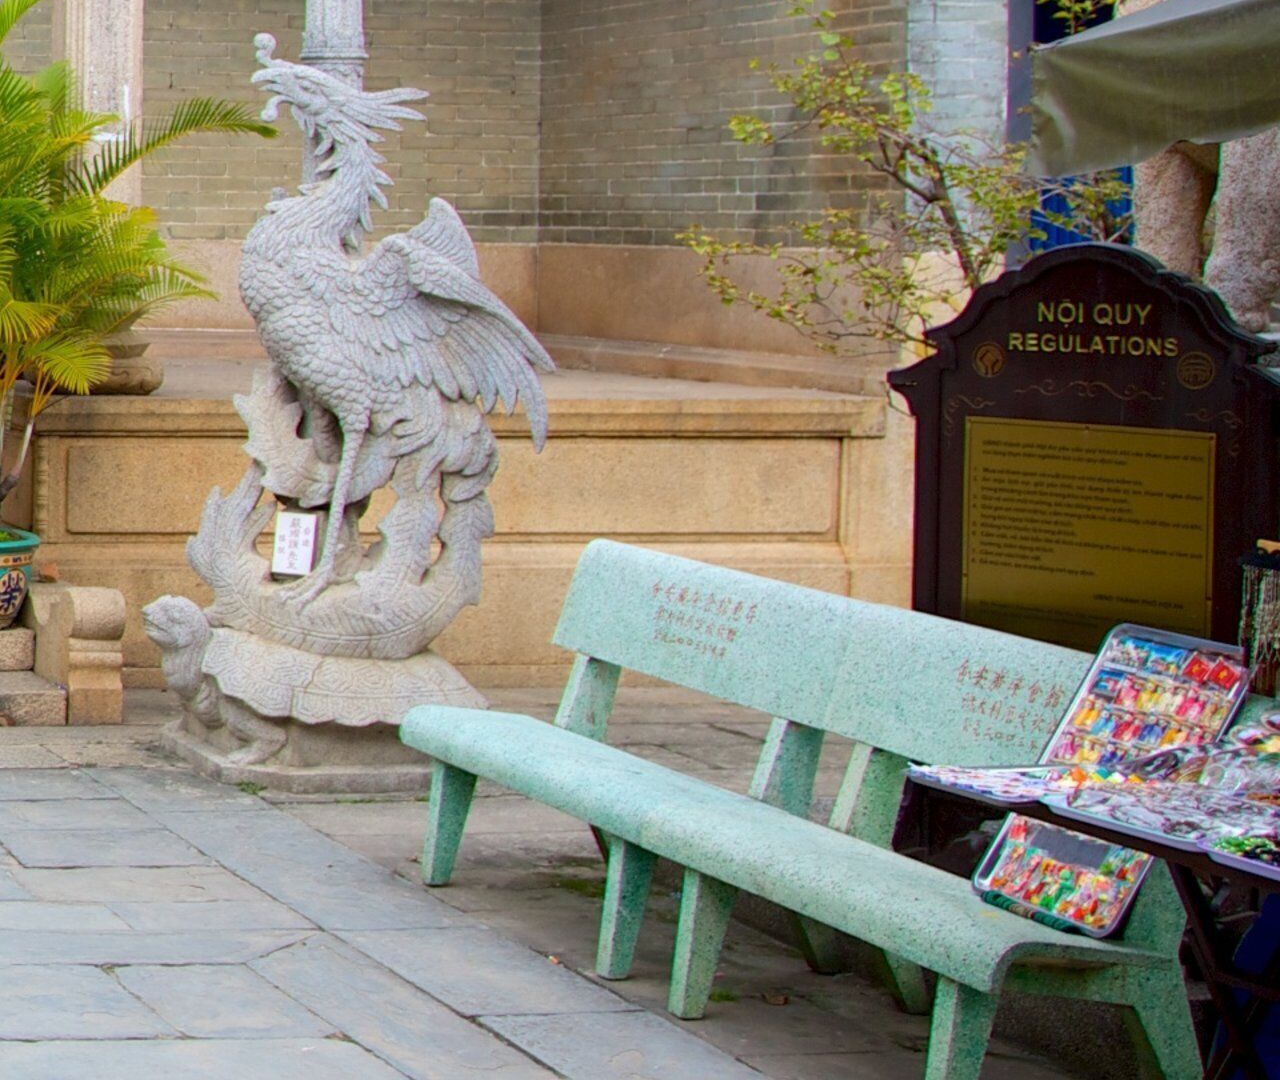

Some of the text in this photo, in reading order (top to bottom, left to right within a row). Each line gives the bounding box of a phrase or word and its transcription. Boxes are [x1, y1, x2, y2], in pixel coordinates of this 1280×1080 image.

[1037, 300, 1152, 329] NỘI QUY
[1008, 331, 1179, 357] REGULATIONS
